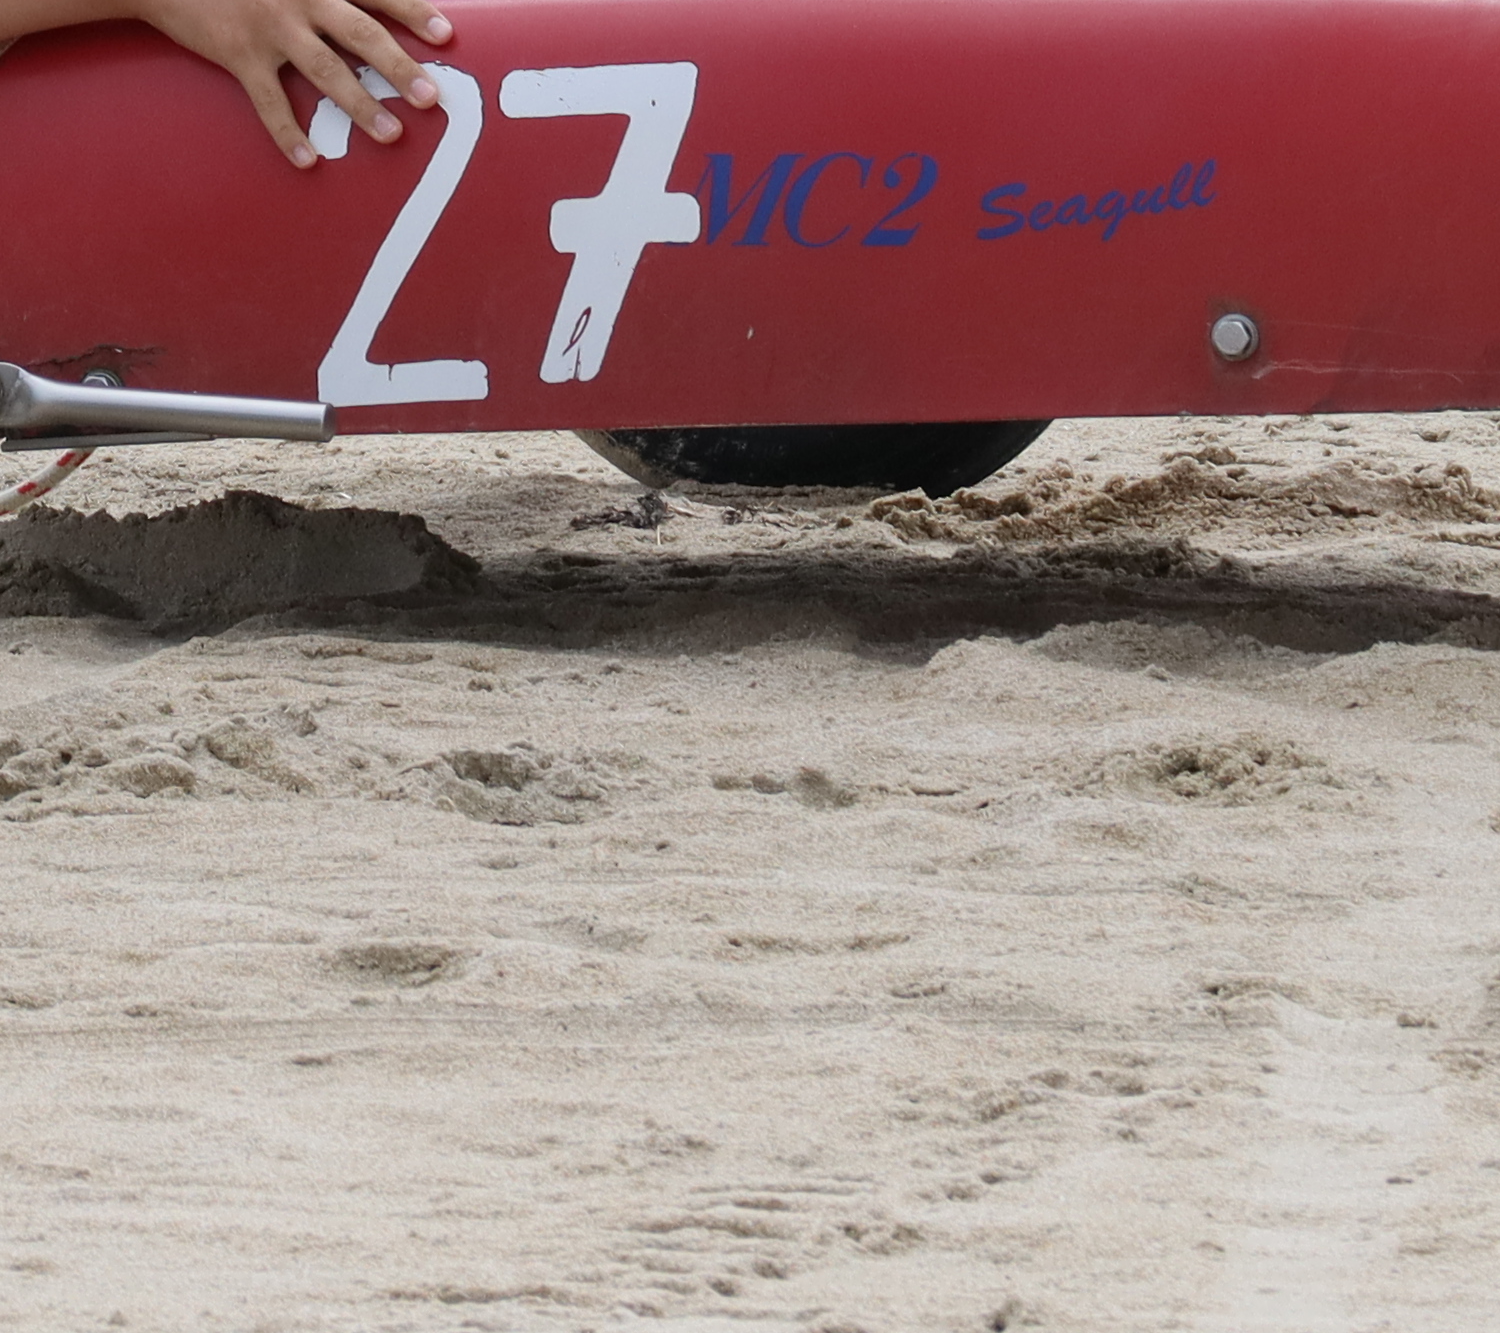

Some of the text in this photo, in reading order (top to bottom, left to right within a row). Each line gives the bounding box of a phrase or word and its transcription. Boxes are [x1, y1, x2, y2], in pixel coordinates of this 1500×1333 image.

[308, 60, 701, 408] 27
[665, 150, 1218, 249] MC2 Seagull
